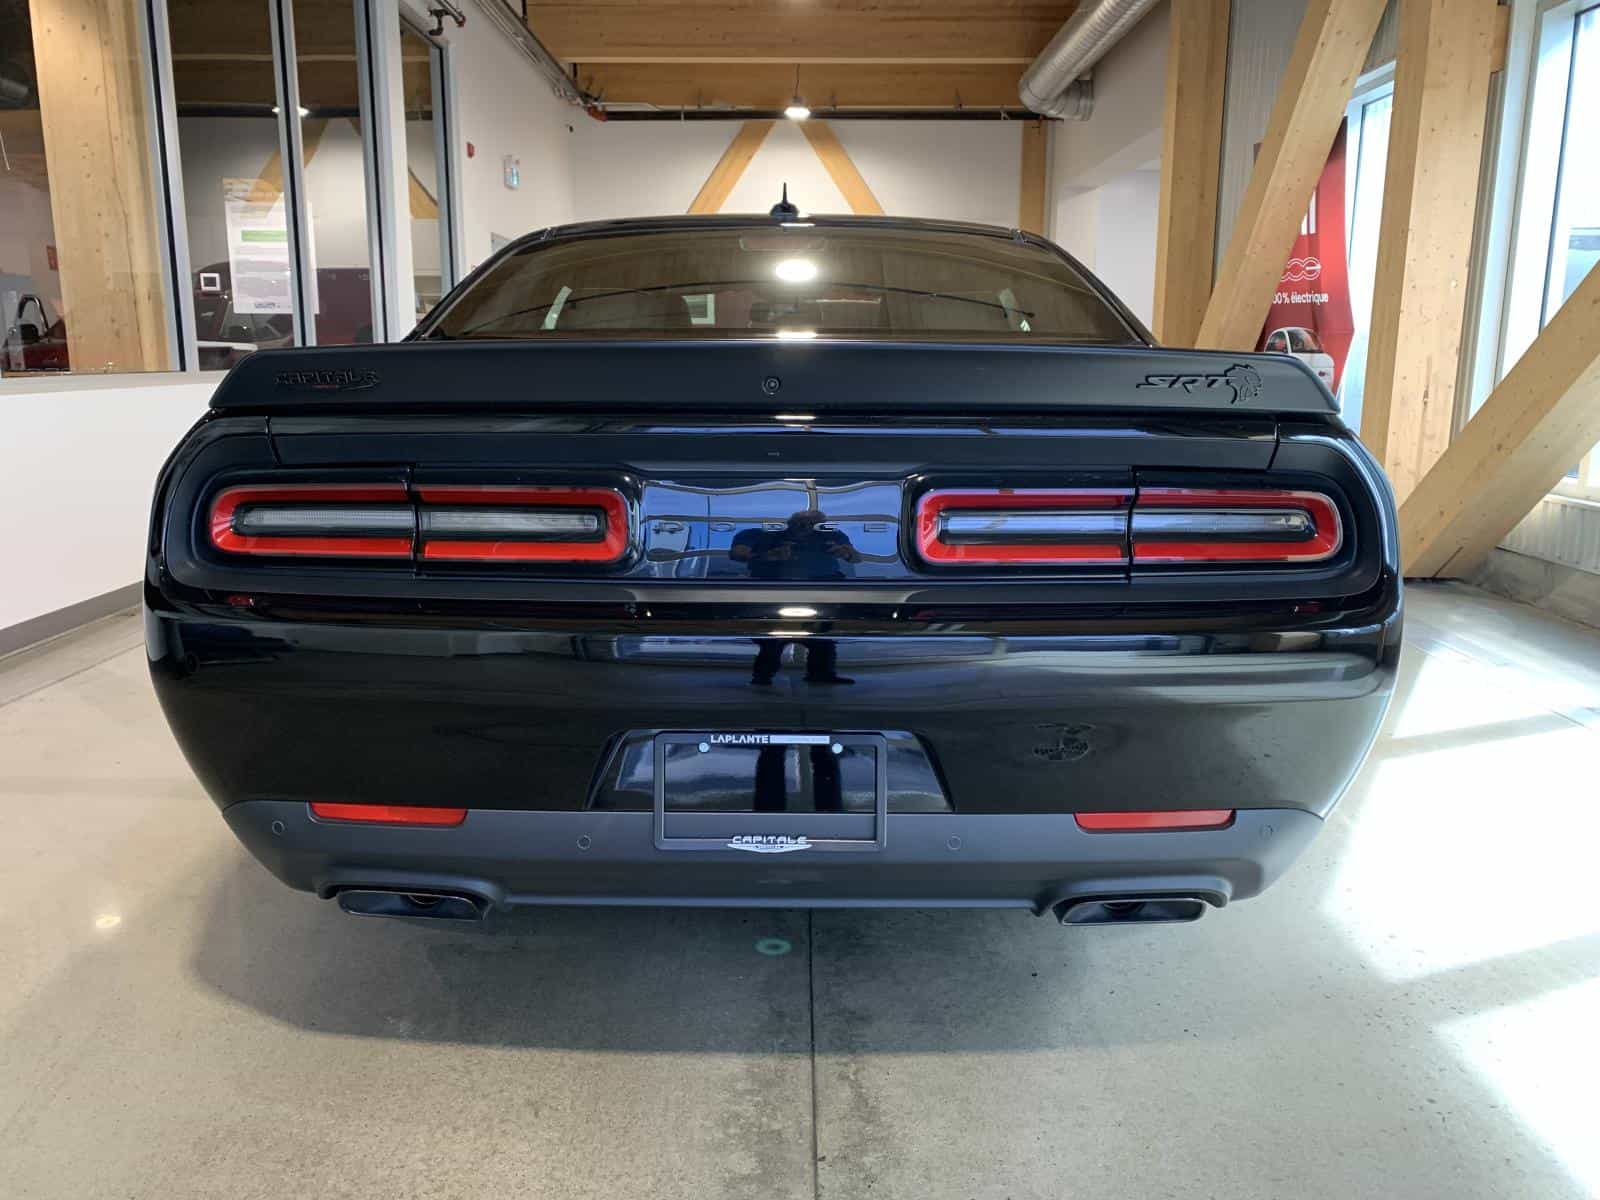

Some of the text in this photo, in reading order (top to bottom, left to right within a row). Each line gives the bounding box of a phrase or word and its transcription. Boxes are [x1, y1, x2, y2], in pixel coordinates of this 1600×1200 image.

[1291, 291, 1329, 306] électrique
[1136, 374, 1228, 393] SRT
[661, 521, 889, 533] DODGE
[710, 734, 769, 744] LAPLANTE
[732, 835, 807, 844] CAPITALE
